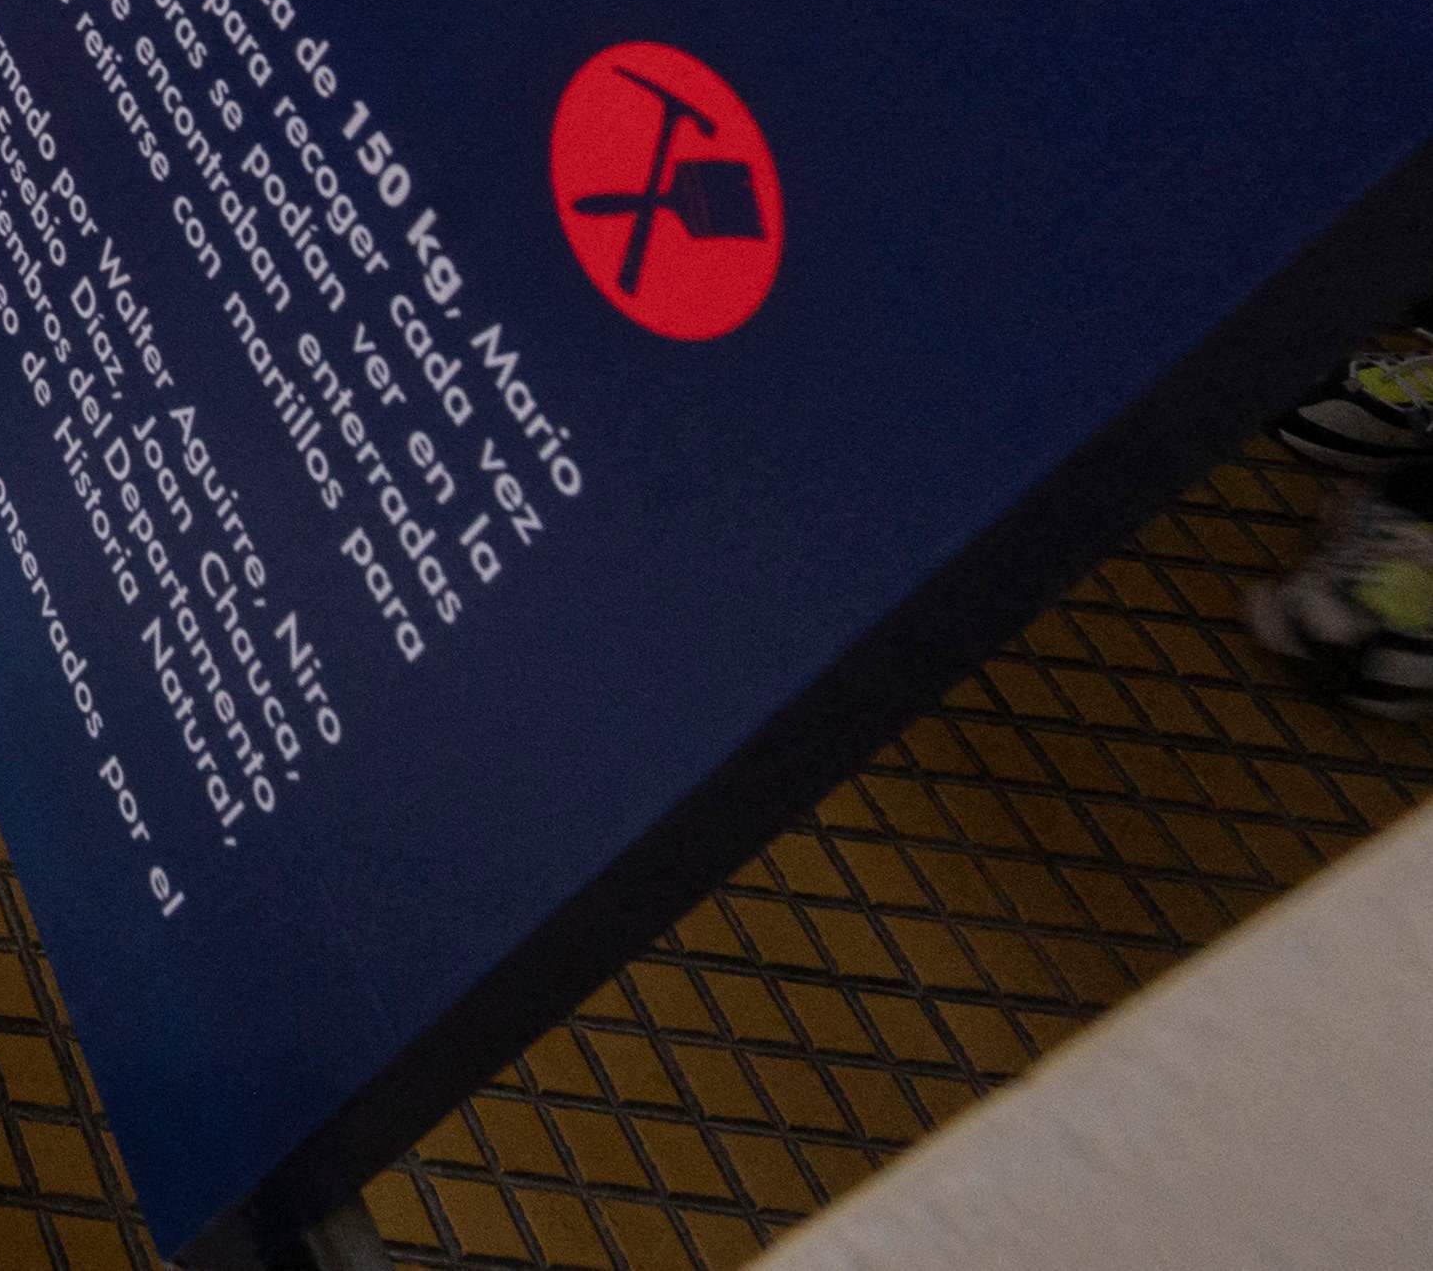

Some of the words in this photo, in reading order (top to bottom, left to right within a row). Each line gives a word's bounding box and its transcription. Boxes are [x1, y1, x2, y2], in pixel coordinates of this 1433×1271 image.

[49, 166, 99, 237] por
[97, 235, 175, 389] Walter
[167, 404, 267, 608] Aguirre,
[273, 610, 342, 745] Niro
[74, 10, 170, 182] retirarse
[171, 194, 222, 280] con
[222, 290, 344, 510] martillos
[338, 525, 426, 663] para
[133, 34, 291, 312] encontraban
[296, 331, 462, 625] enterradas
[207, 77, 244, 132] se
[239, 142, 346, 312] podían
[352, 322, 407, 406] ver
[406, 429, 456, 505] en
[458, 512, 502, 584] la
[272, 94, 390, 274] recoger
[388, 292, 474, 426] cada
[478, 437, 544, 545] vez
[294, 35, 338, 99] de
[341, 98, 412, 208] 150
[405, 206, 463, 319] kg,
[469, 322, 583, 497] Mario
